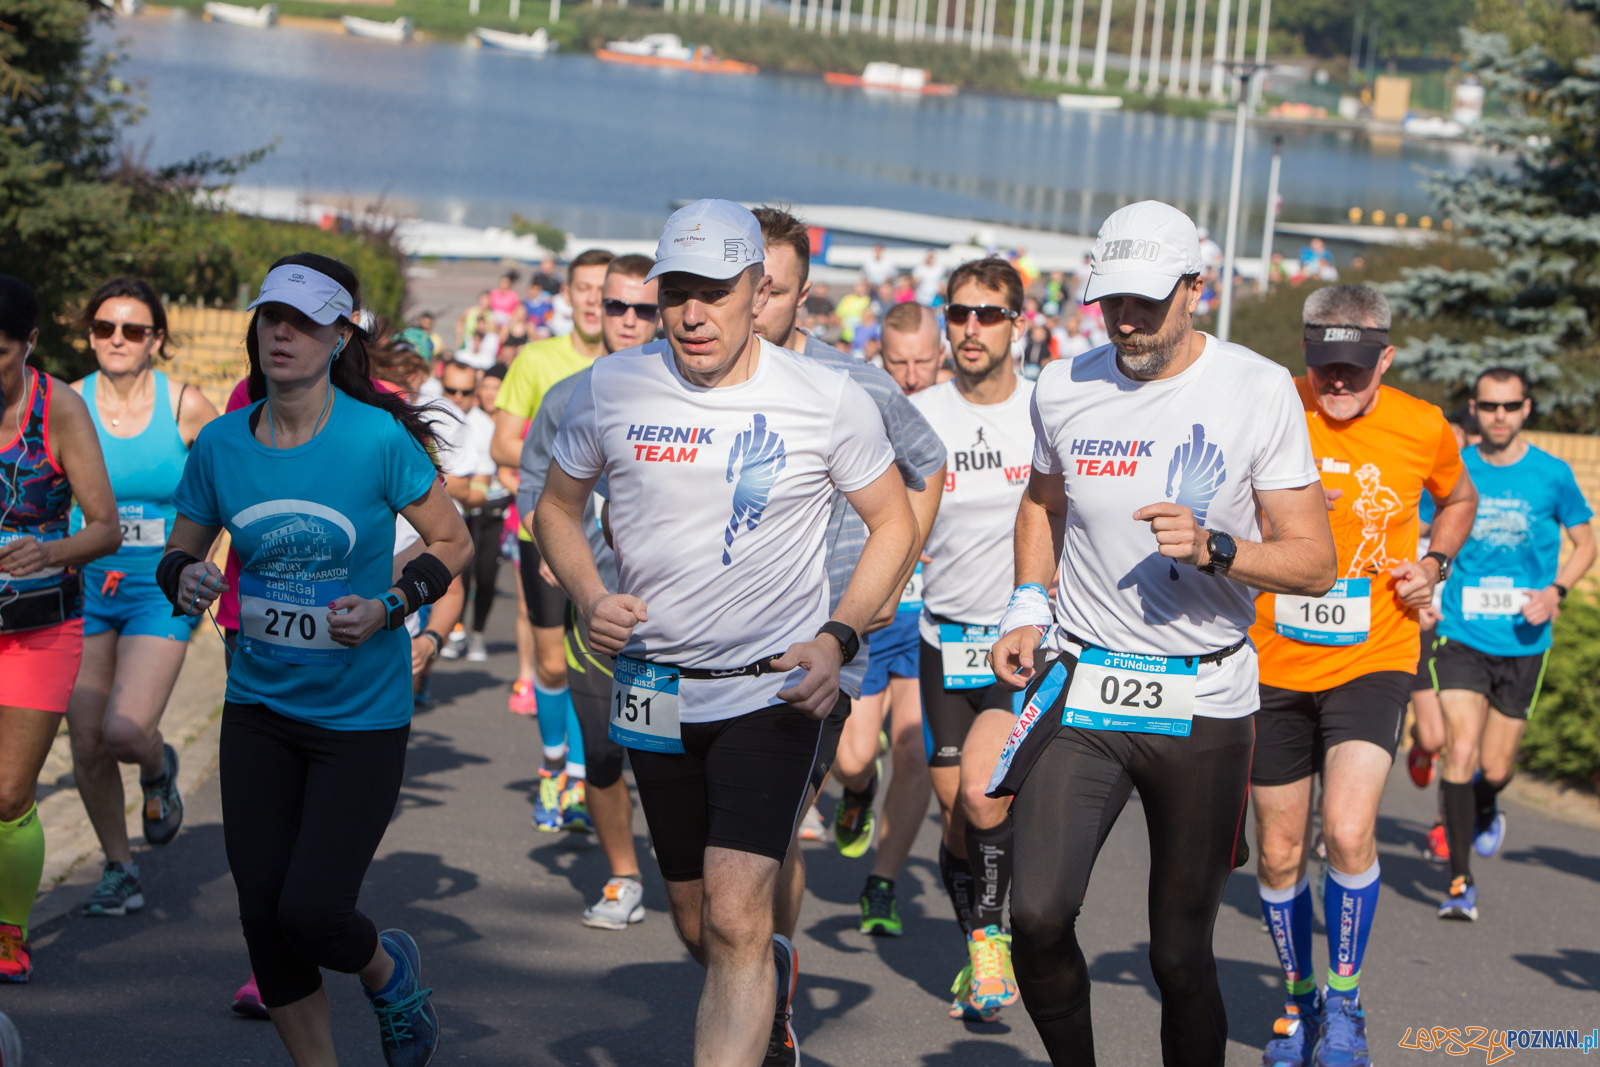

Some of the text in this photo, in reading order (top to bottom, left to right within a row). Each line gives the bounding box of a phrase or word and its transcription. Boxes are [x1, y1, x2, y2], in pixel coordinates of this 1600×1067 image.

[626, 424, 716, 444] HERNIK
[633, 444, 699, 463] TEAM
[1070, 439, 1156, 457] HERNIK
[954, 450, 1003, 472] RUN
[1075, 459, 1138, 477] TEAM
[272, 591, 316, 606] FUNdusze
[1480, 592, 1513, 608] 338
[1299, 602, 1346, 625] 160
[264, 607, 317, 641] 270
[1104, 657, 1167, 673] o FUNdusze
[1100, 675, 1163, 709] 023
[615, 690, 651, 726] 151
[1009, 705, 1039, 746] TEAM
